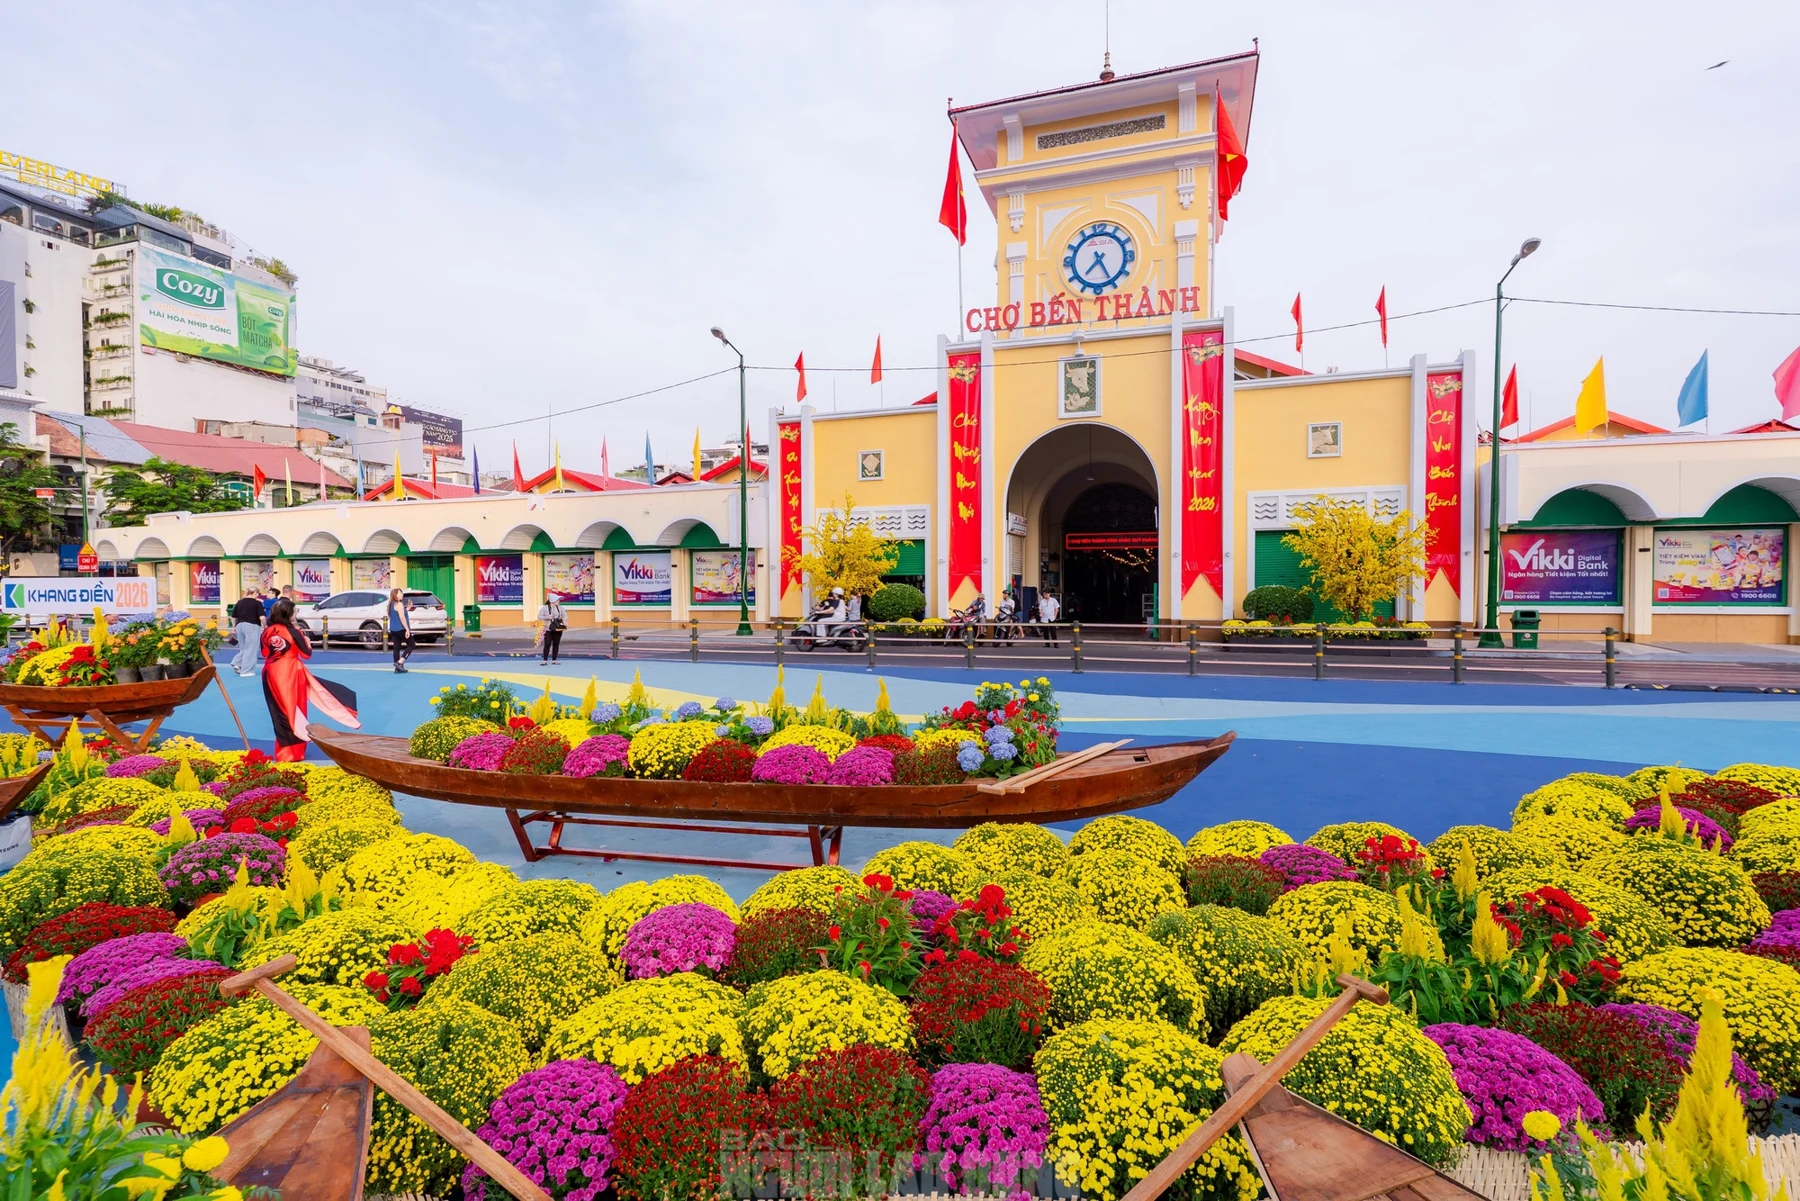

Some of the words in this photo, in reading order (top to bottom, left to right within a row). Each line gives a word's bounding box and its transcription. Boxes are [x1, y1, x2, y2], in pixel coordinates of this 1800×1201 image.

[1092, 223, 1107, 234] 12
[1126, 250, 1135, 262] 3
[163, 272, 218, 304] Cozy
[966, 302, 1020, 332] CHỢ
[1030, 292, 1083, 326] BẾN
[1096, 285, 1200, 322] THÀNH
[243, 330, 272, 350] MATCHA
[1184, 394, 1220, 425] Happy
[1428, 410, 1455, 424] Chợ
[953, 412, 978, 428] Chúc
[437, 432, 454, 442] 2025
[1432, 436, 1451, 452] Vui
[1428, 464, 1454, 480] Bến
[1188, 496, 1215, 512] 2026
[1426, 492, 1457, 512] Thành
[1659, 536, 1681, 546] Vikki
[1508, 538, 1574, 570] Vikki
[297, 564, 322, 583] Vikki
[479, 560, 509, 581] Vikki
[619, 557, 652, 579] Vikki
[1578, 561, 1608, 570] Bank
[193, 566, 216, 584] Vikki
[28, 589, 76, 602] KHANG
[79, 580, 113, 602] ĐIỀN
[116, 582, 149, 608] 2026
